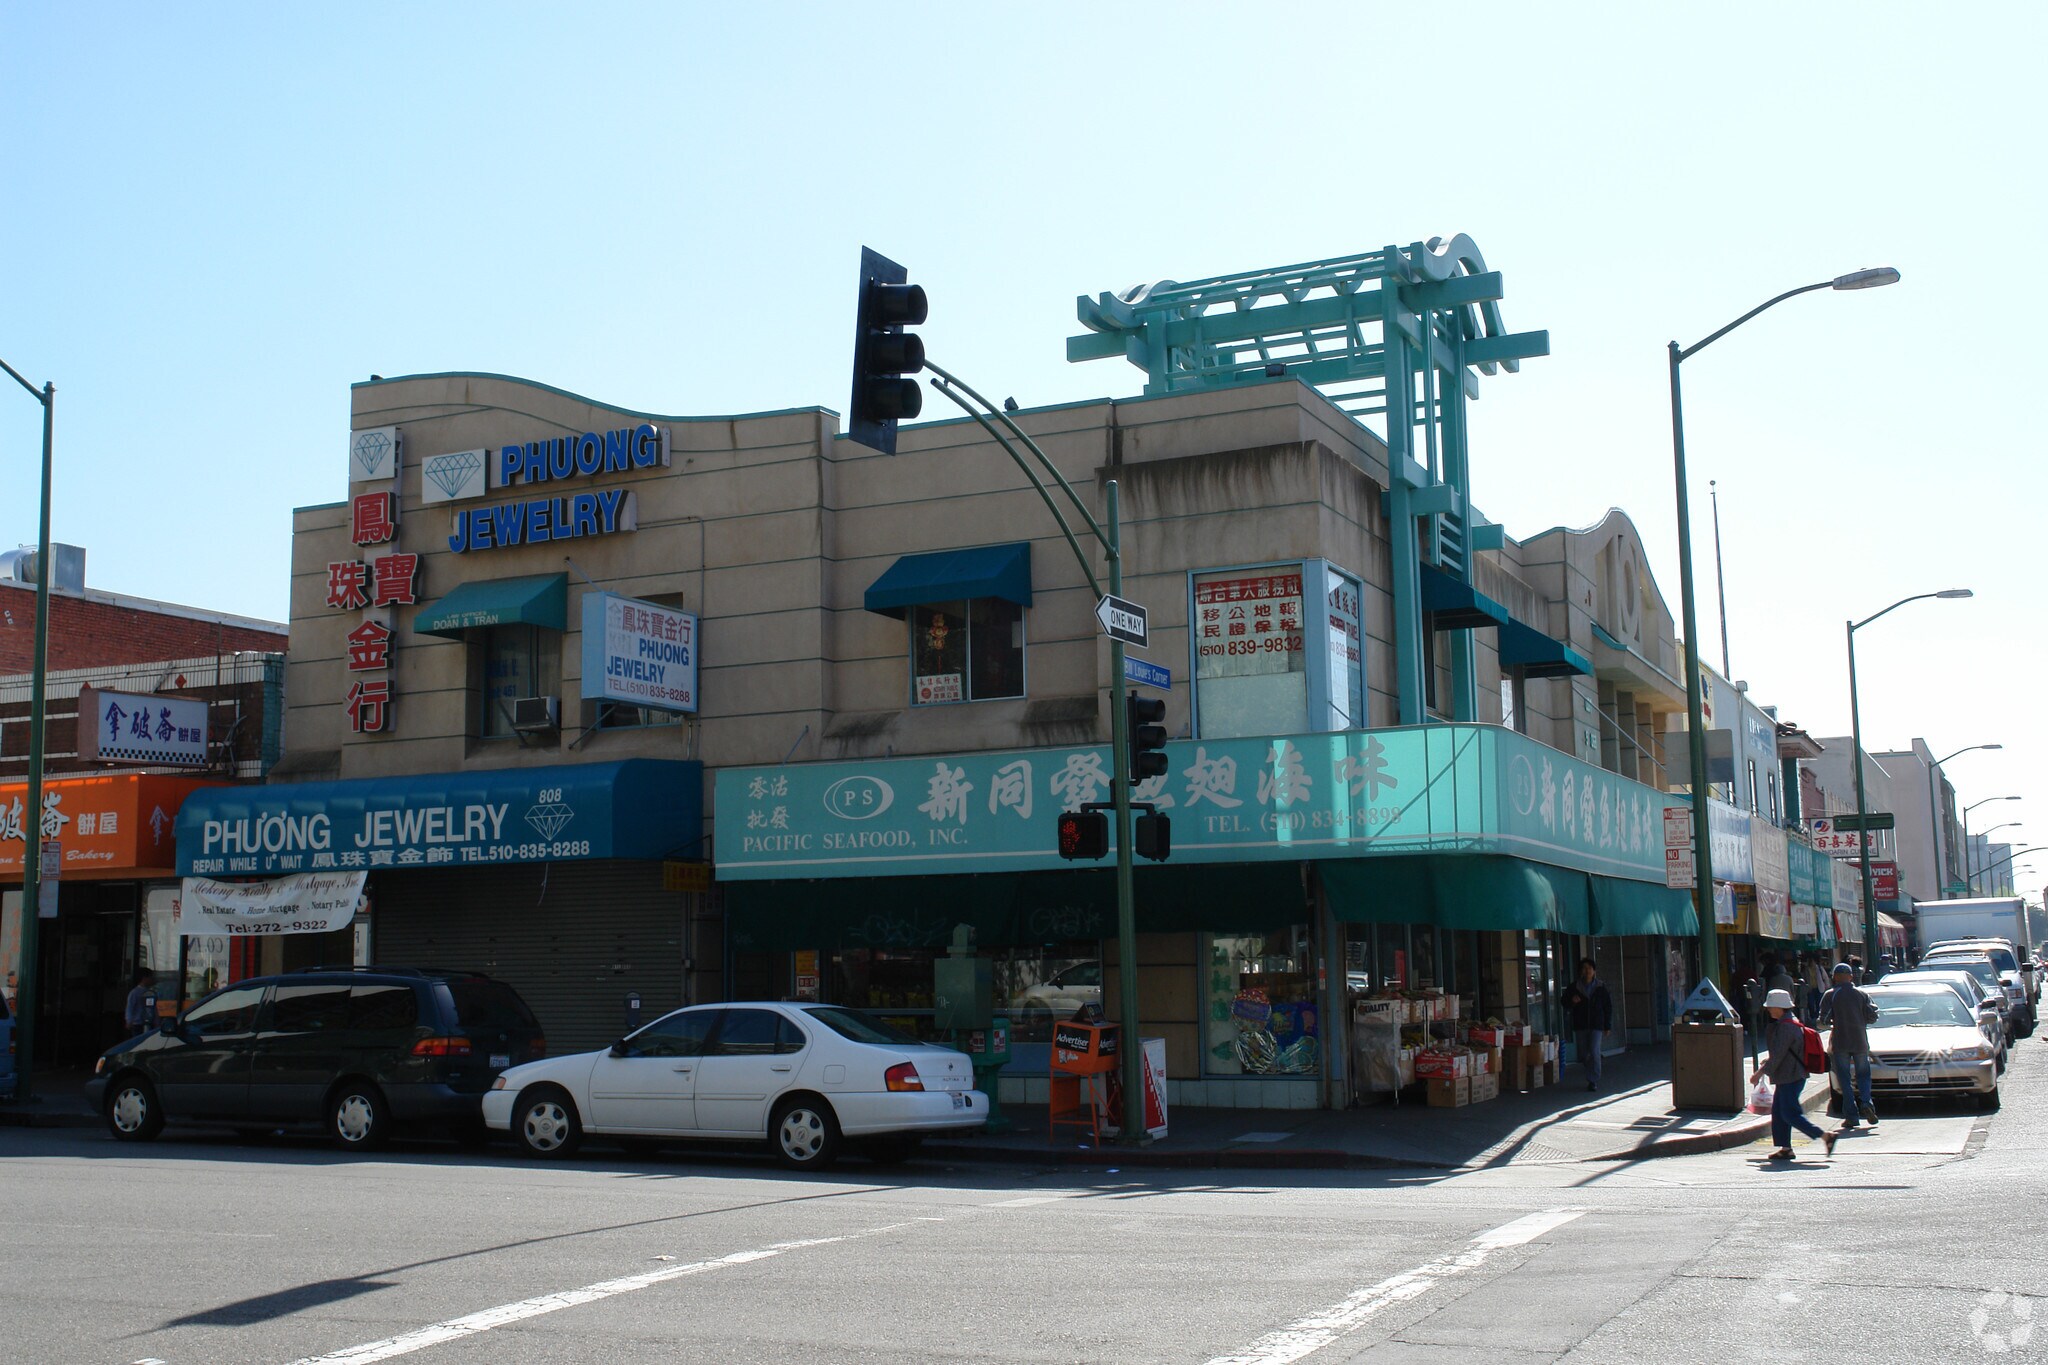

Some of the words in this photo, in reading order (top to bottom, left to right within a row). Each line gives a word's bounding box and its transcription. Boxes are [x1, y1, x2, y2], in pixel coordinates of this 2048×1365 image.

[501, 423, 660, 487] PHUONG
[448, 489, 627, 554] JEWELRY
[433, 619, 459, 630] DOAN
[463, 617, 469, 627] &
[474, 614, 499, 626] TRAN
[622, 606, 691, 644] 鳳珠寶金行
[1110, 610, 1125, 628] ONE
[1127, 616, 1142, 634] WAY
[639, 637, 690, 666] PHUONG
[1200, 644, 1225, 657] (510)
[1228, 636, 1302, 656] 839-9832
[607, 655, 666, 684] JEWELRY
[1152, 669, 1168, 685] Corner
[649, 685, 690, 703] 835-8288
[539, 788, 562, 804] 808
[354, 803, 510, 848] JEWELRY
[1204, 815, 1251, 834] TEL.
[1260, 811, 1306, 834] (510)
[461, 840, 590, 862] TEL.510-835-8288
[743, 834, 813, 853] PACIFIC
[822, 830, 916, 850] SEAFOOD,
[929, 828, 968, 846] INC.
[66, 849, 114, 861] Bakery
[193, 858, 224, 874] REPAIR
[230, 857, 257, 872] WHILE
[280, 855, 303, 870] WAIT
[1667, 851, 1678, 860] NO
[191, 882, 233, 900] Mekong
[202, 905, 215, 915] Real
[216, 906, 236, 915] Estate
[247, 906, 266, 915] Home
[267, 904, 300, 916] Mortgage
[311, 900, 333, 911] Notary
[1057, 1033, 1089, 1047] Advertiser
